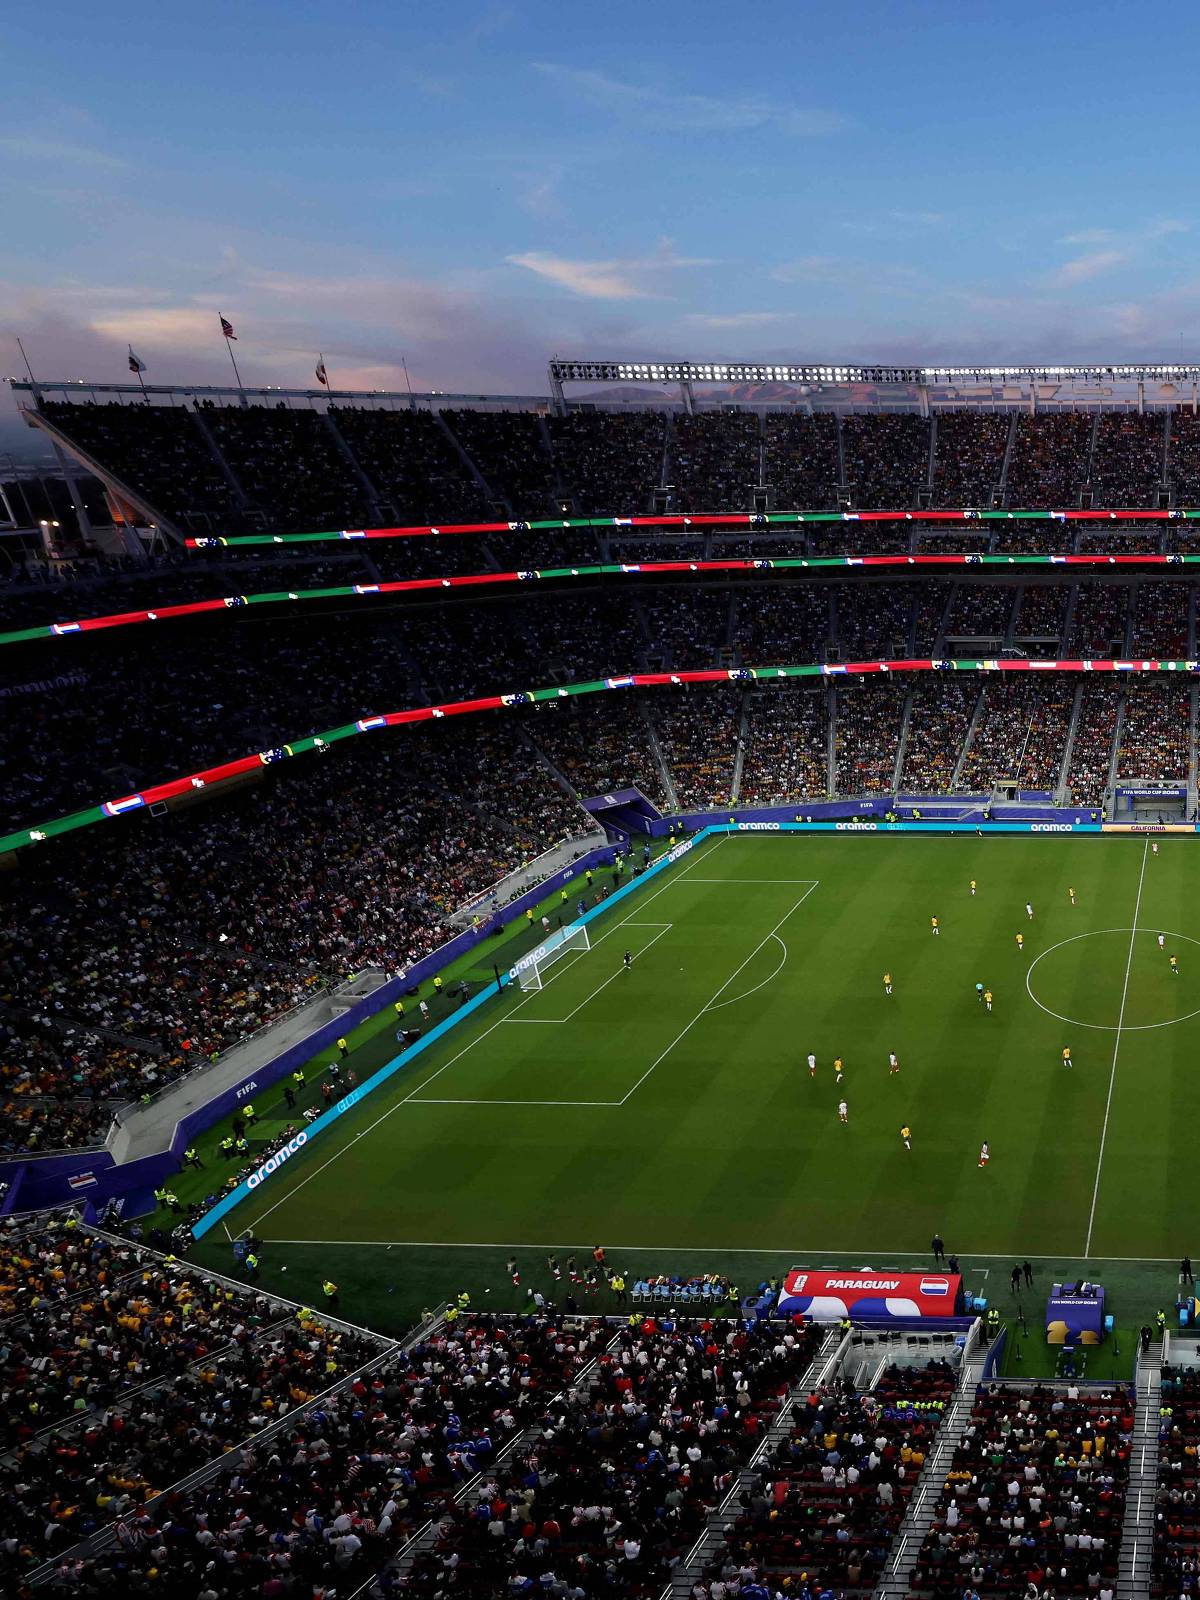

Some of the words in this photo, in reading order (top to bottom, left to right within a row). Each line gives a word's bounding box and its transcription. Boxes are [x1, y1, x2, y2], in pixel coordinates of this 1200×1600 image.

[738, 822, 780, 831] aramco
[835, 823, 877, 831] aramco
[1031, 824, 1072, 832] aramco
[668, 840, 693, 862] aramco
[563, 870, 574, 880] FIFA
[509, 946, 546, 979] aramco
[236, 1081, 258, 1099] FIFA
[247, 1131, 308, 1189] aramco
[825, 1279, 900, 1290] PARAGUAY
